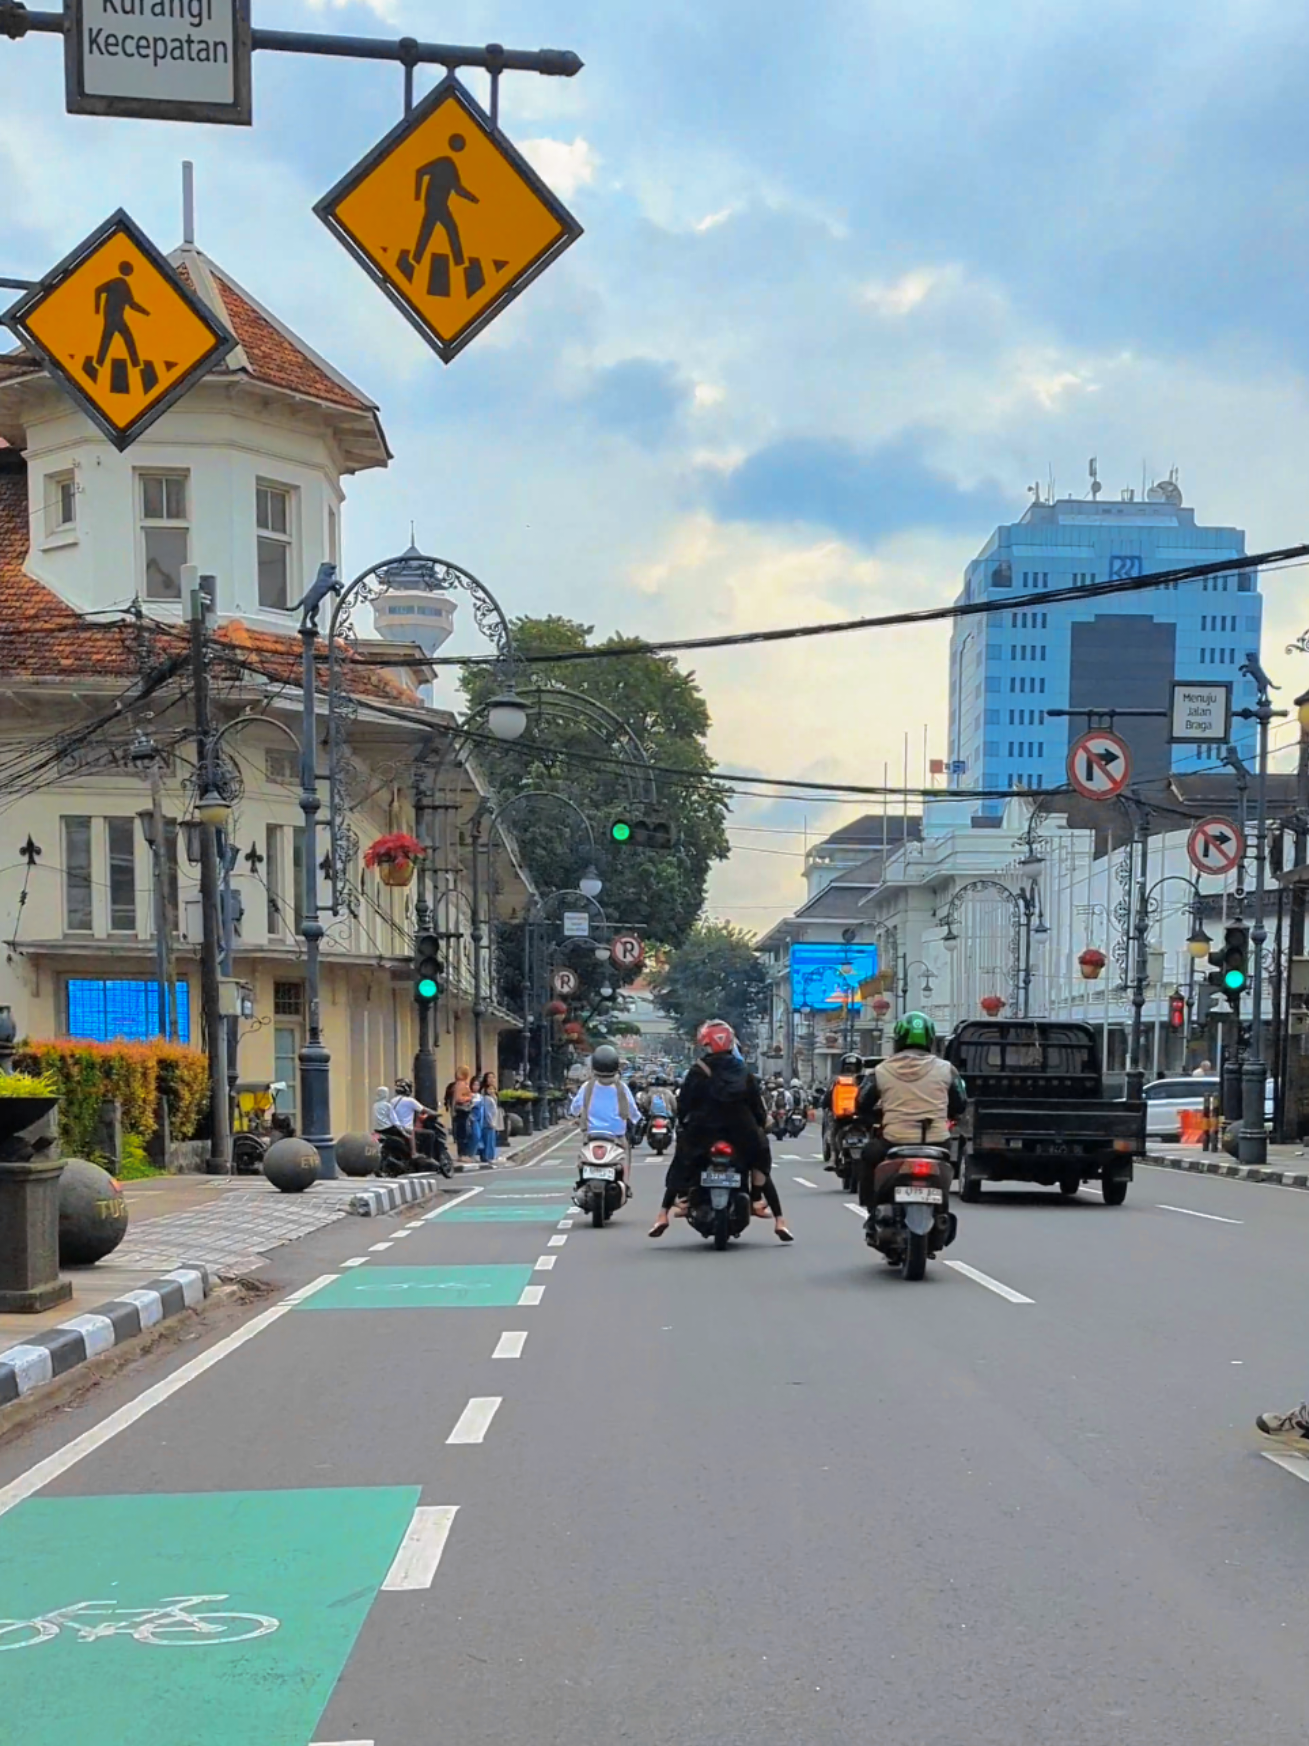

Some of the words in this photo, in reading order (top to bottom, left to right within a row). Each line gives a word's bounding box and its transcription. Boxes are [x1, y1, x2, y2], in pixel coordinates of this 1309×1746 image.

[88, 27, 229, 66] Kecepatan
[1183, 693, 1217, 706] Menuju
[1187, 706, 1212, 717] Jalan
[1185, 720, 1212, 733] Braga
